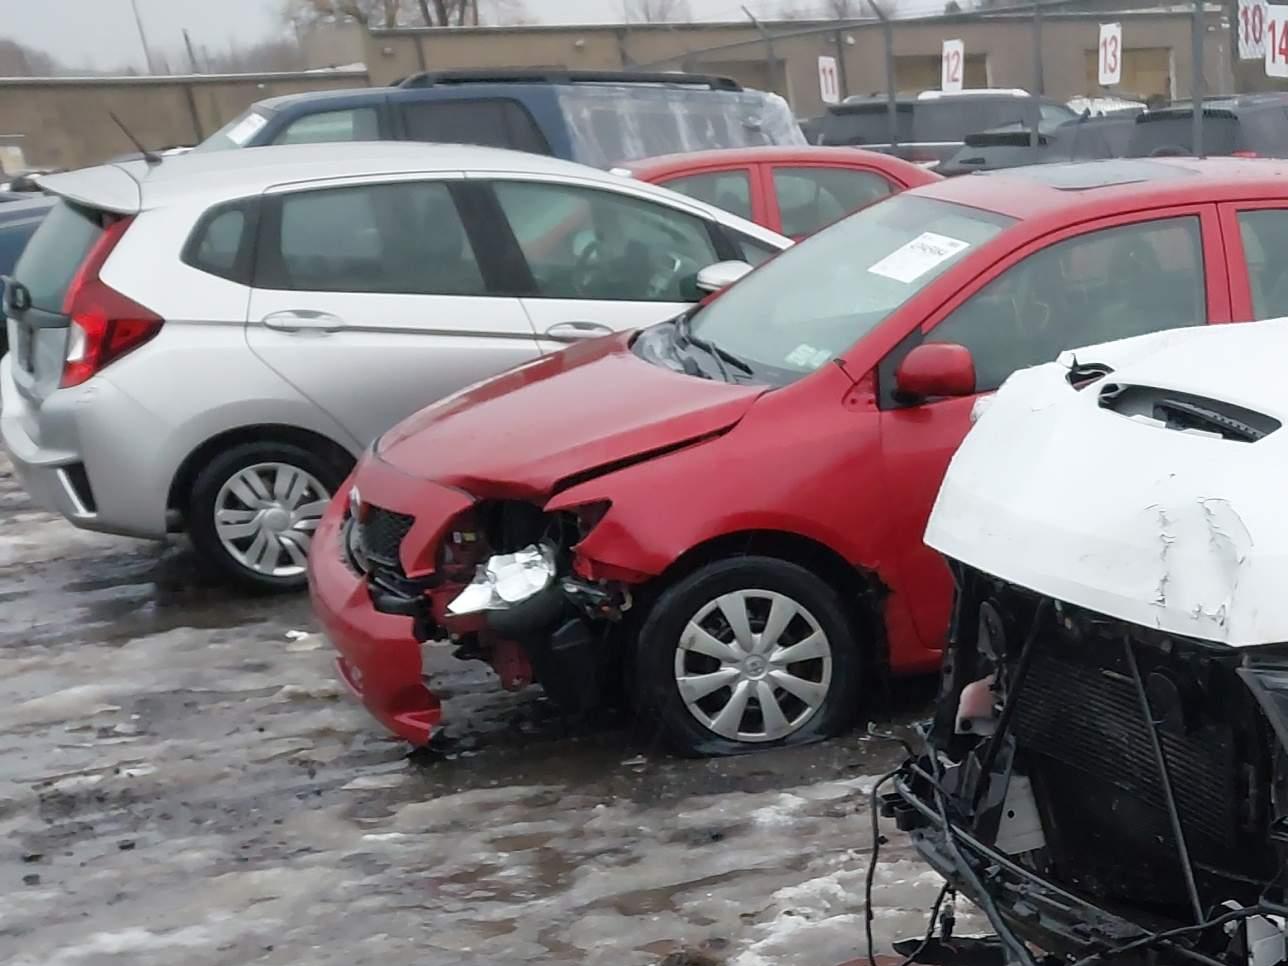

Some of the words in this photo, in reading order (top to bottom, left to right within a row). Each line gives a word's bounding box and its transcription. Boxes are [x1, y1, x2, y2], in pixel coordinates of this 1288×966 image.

[1240, 4, 1263, 44] 10
[944, 50, 961, 82] 12
[1102, 35, 1118, 74] 13
[821, 67, 840, 95] 11
